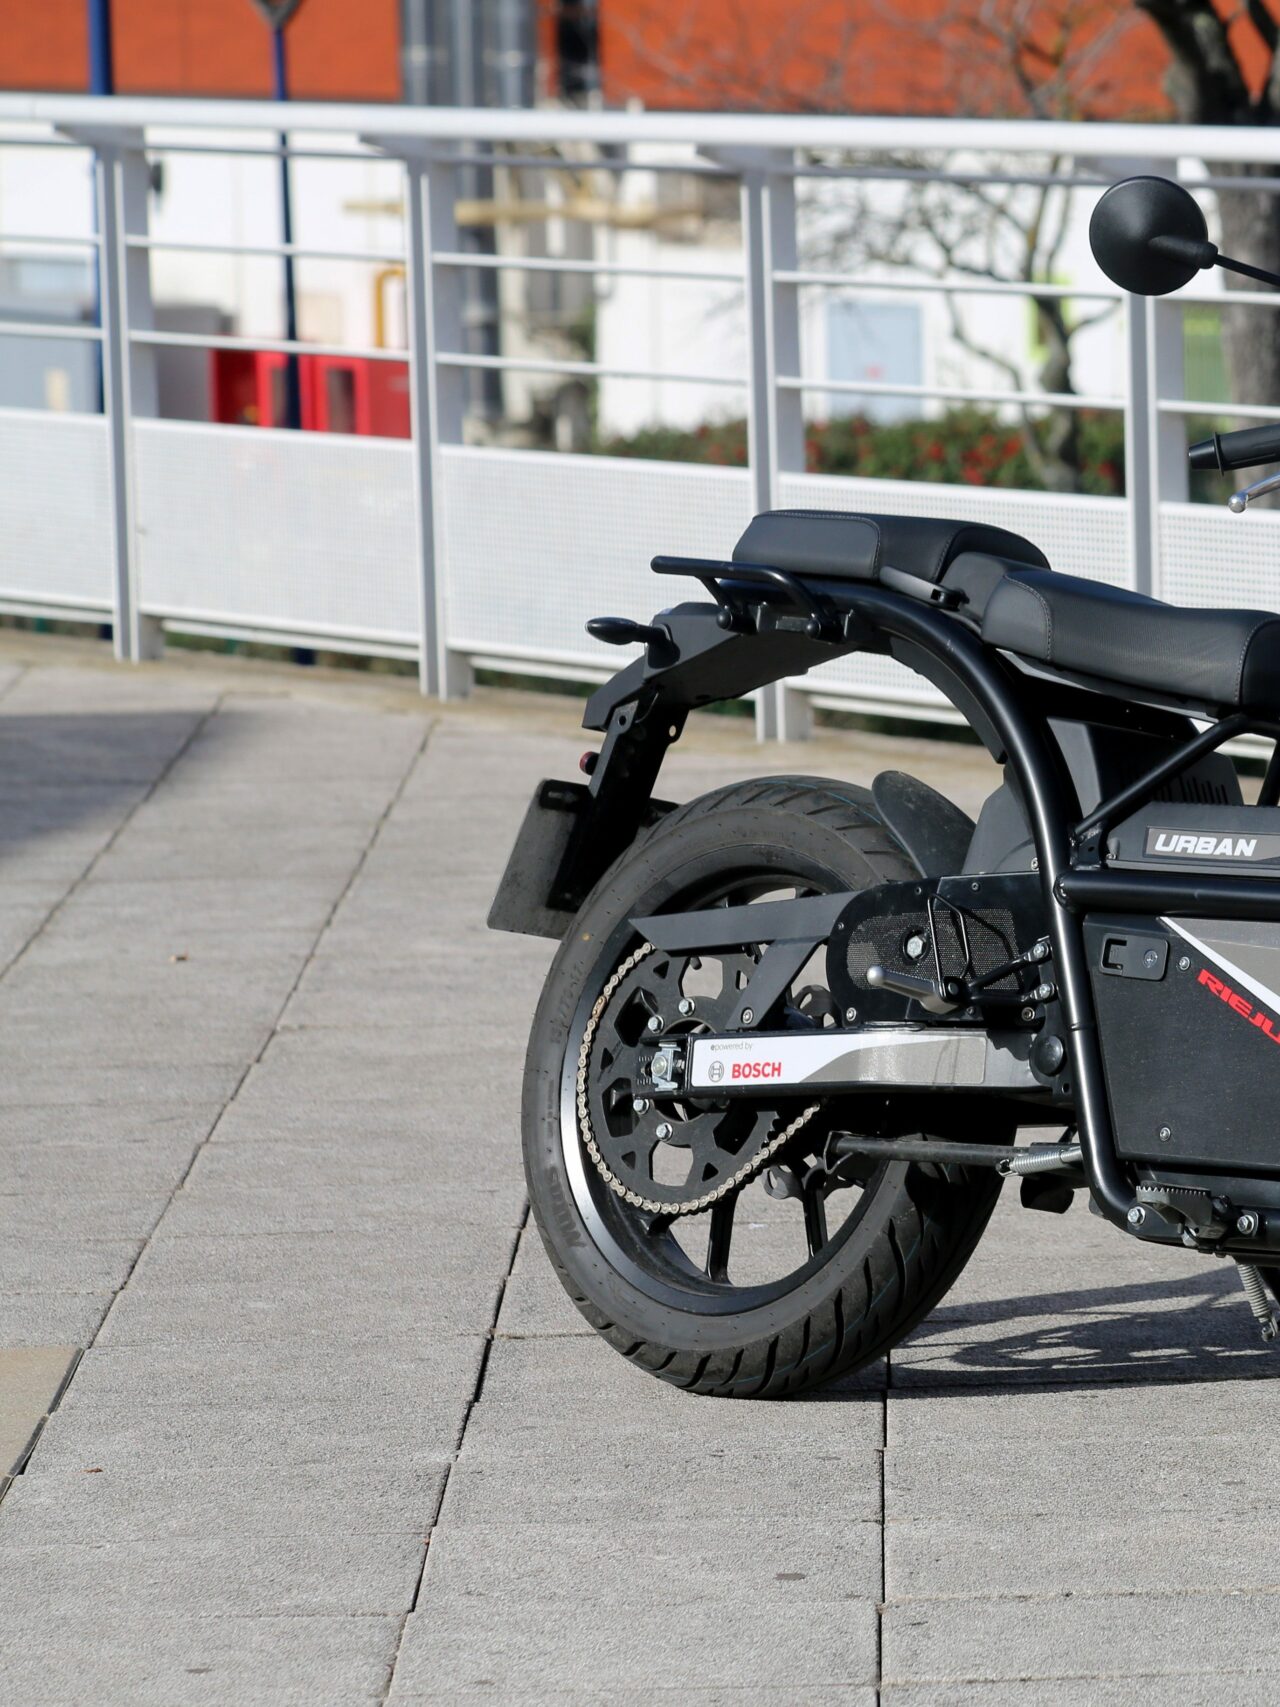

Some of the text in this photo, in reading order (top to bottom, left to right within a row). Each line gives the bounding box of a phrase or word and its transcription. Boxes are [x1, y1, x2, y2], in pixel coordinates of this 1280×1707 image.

[1154, 833, 1258, 857] URBAN
[744, 1041, 753, 1052] by
[731, 1062, 782, 1079] BOSCH
